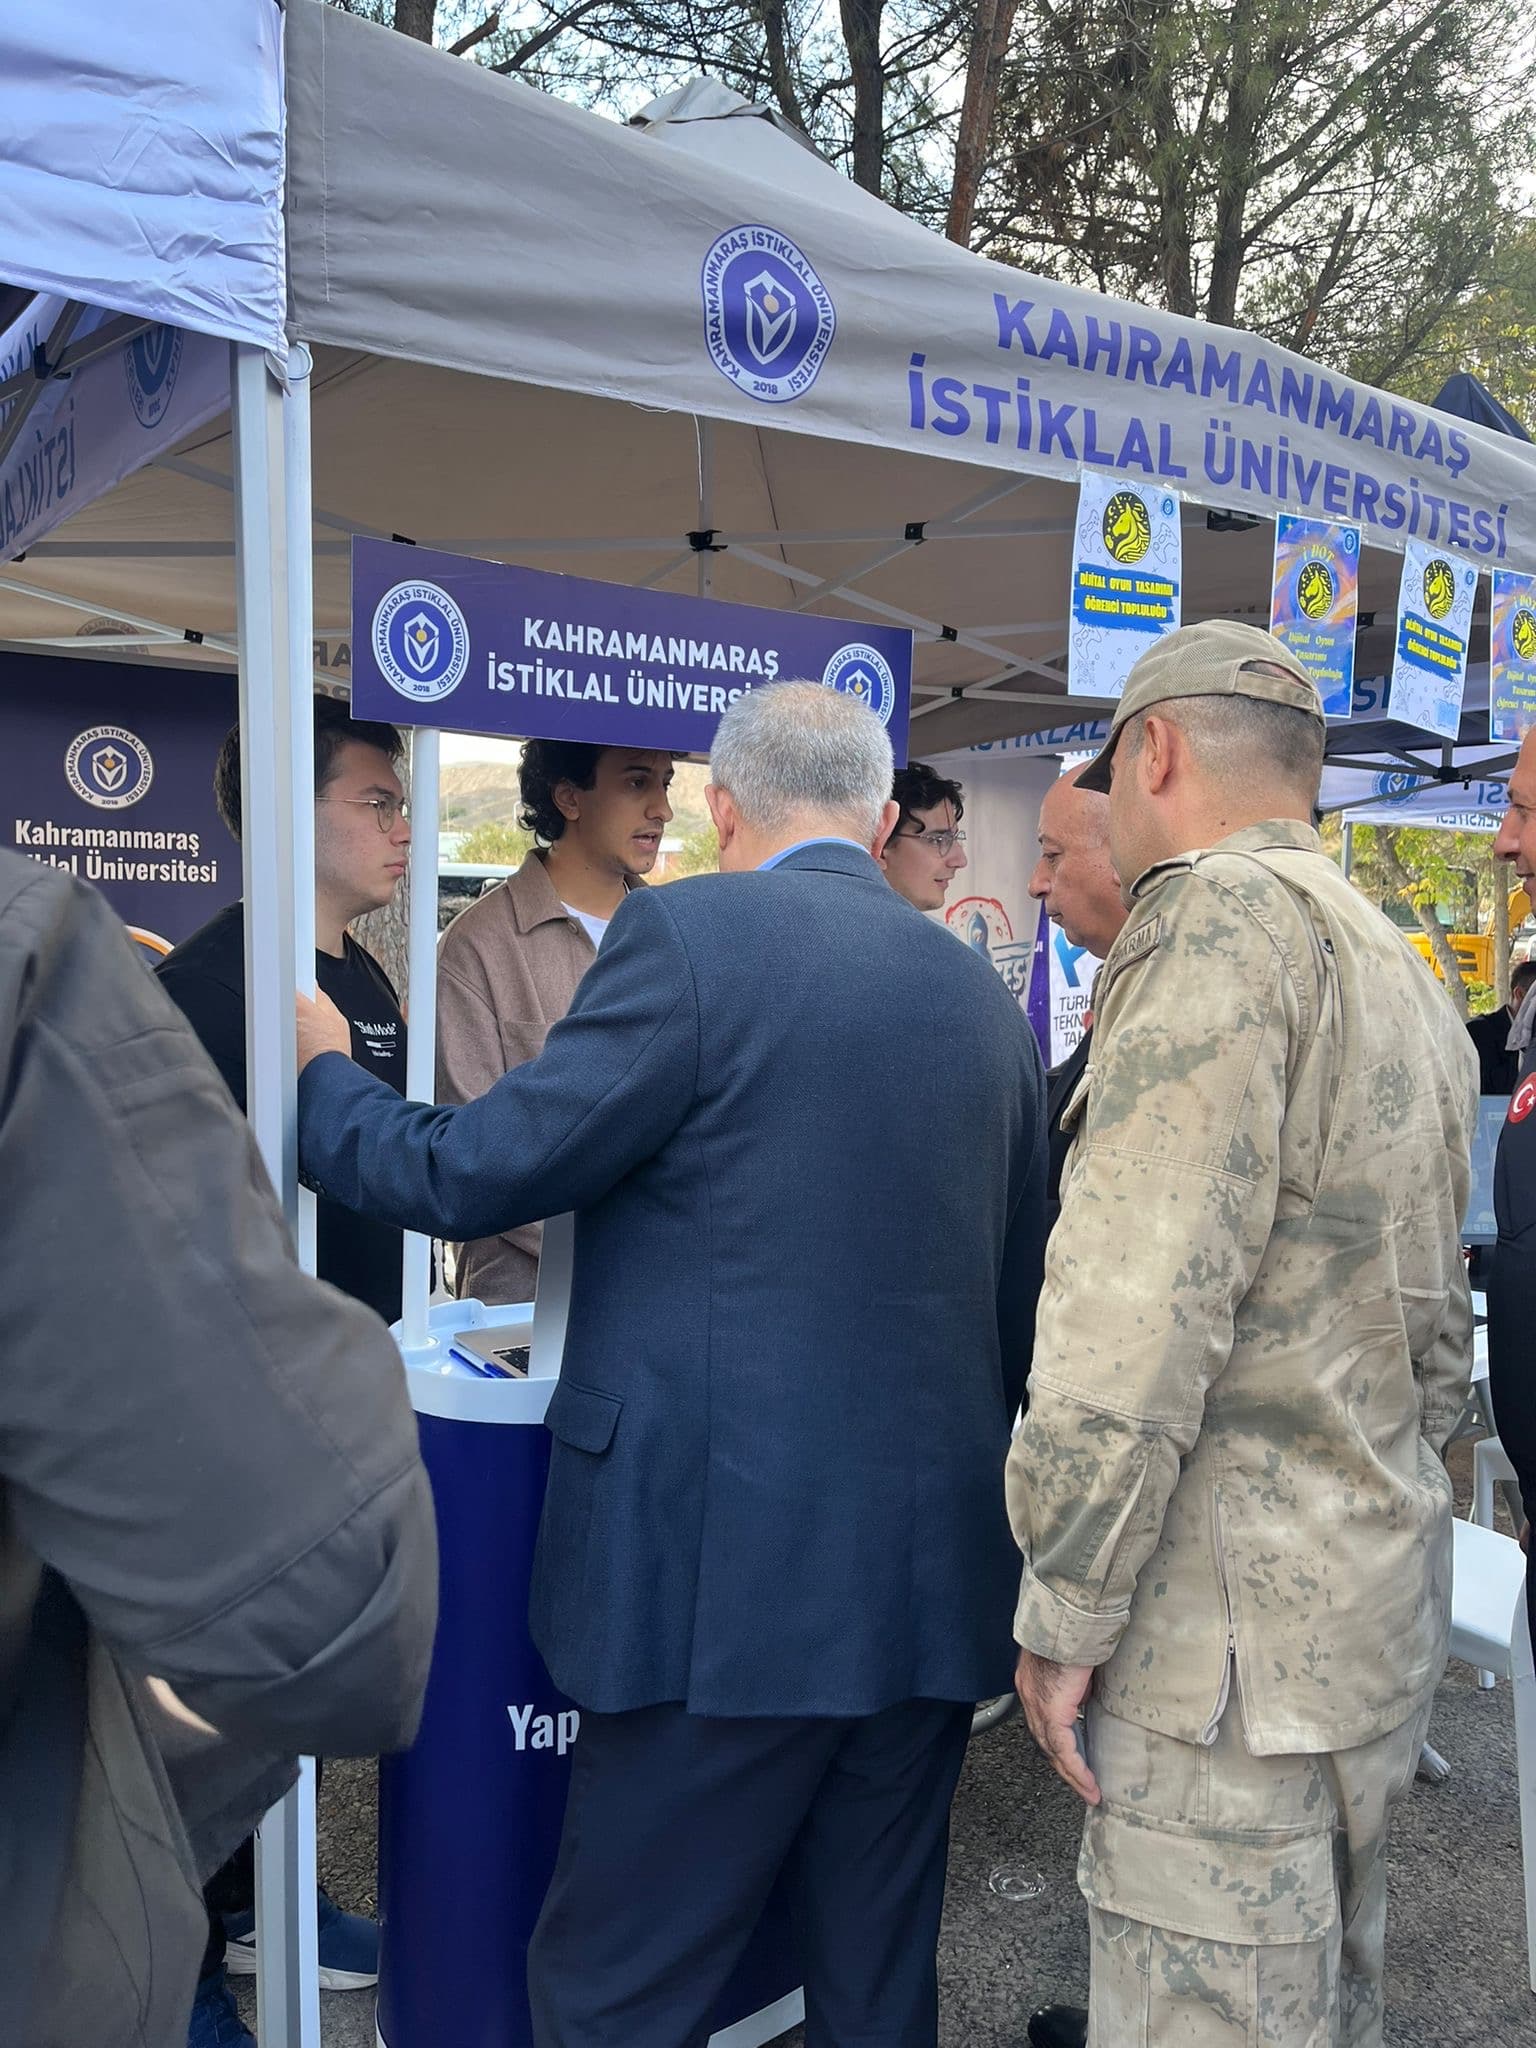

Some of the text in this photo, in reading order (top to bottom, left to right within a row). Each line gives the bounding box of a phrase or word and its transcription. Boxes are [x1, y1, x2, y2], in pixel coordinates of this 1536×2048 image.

[706, 230, 833, 393] KAHRAMANMARAŞ İSTİKLAL ÜNİVERSİTESİ
[753, 380, 779, 395] 2018
[993, 292, 1472, 479] KAHRAMANMARAŞ
[908, 351, 1508, 560] İSTİKLAL ÜNİVERSİTESİ
[378, 588, 463, 690] KAHRAMANMARAŞ İSTİKLAL ÜNİVERSİTESİ
[523, 616, 779, 680] KAHRAMANMARAŞ
[487, 650, 620, 704] İSTİKLAL
[100, 728, 140, 749] İSTİKLAL
[15, 819, 200, 857] Kahramanmaraş
[86, 849, 217, 882] Üniversitesi
[507, 1703, 580, 1755] Yap
